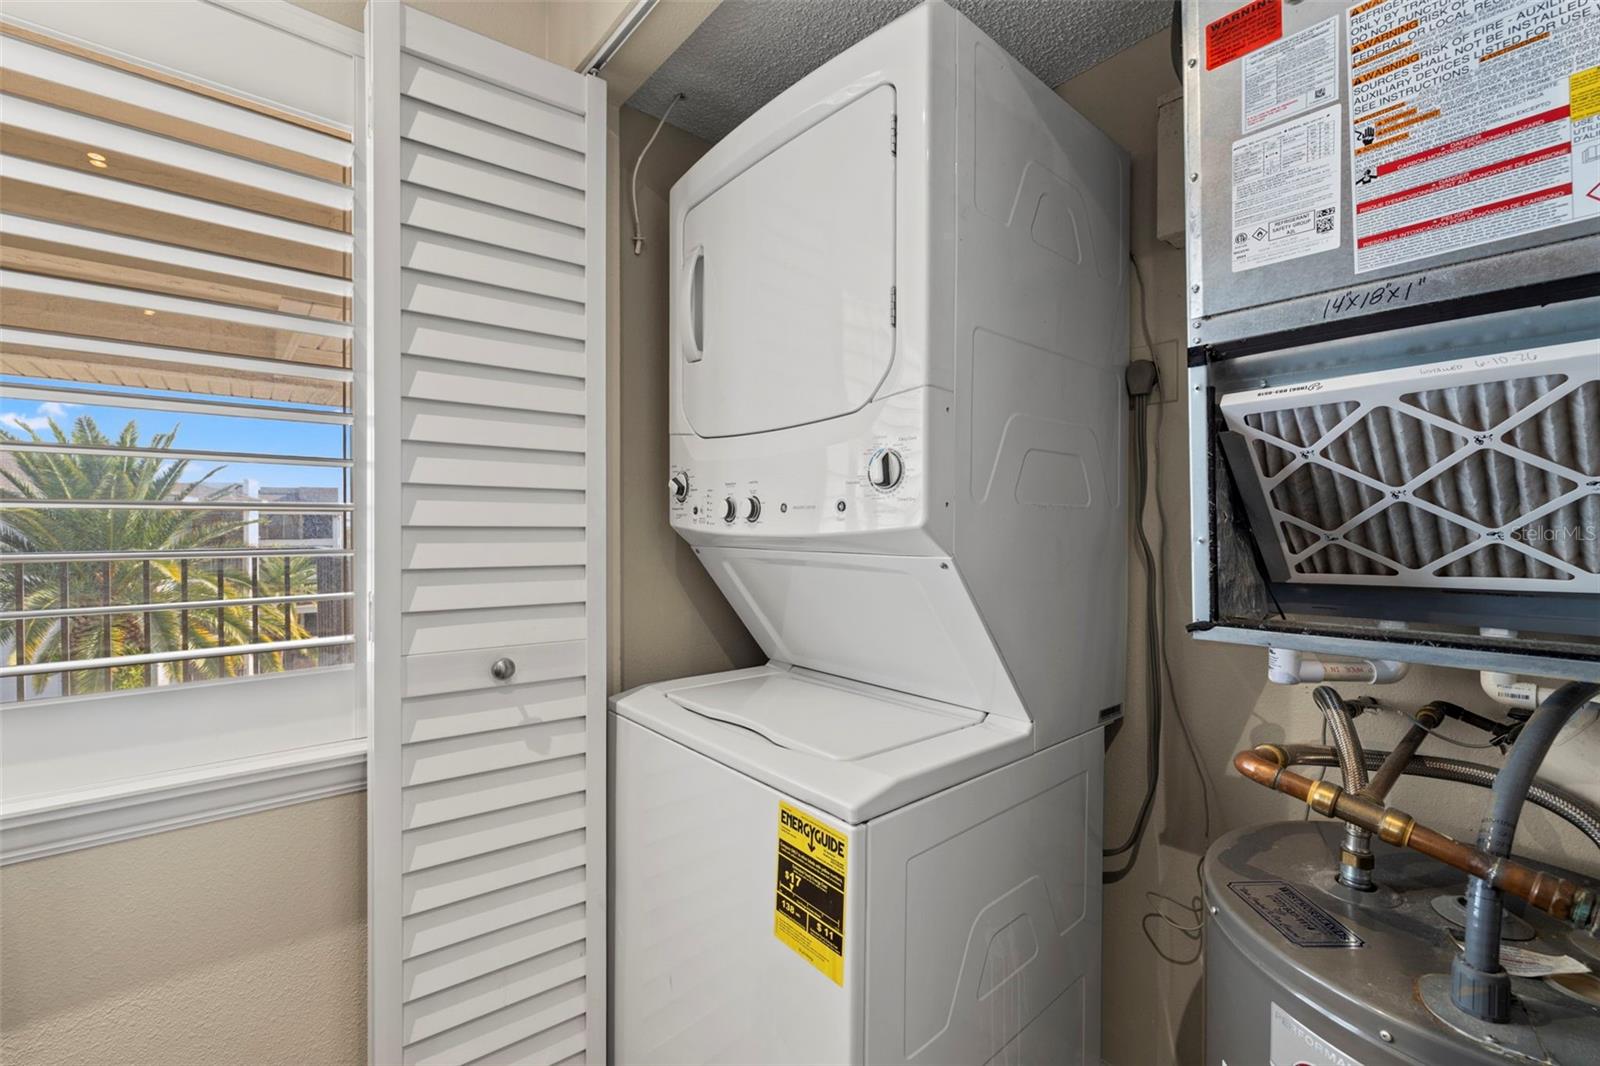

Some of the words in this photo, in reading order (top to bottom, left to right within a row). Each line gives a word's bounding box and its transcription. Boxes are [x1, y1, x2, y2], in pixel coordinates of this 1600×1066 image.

[1351, 16, 1382, 36] ONLY
[1384, 8, 1398, 21] BY
[1352, 31, 1367, 45] DO
[1370, 19, 1394, 37] NOT
[1353, 35, 1402, 63] FEDERAL
[1407, 26, 1424, 40] OR
[1430, 7, 1470, 30] LOCAL
[1361, 19, 1418, 50] WARNING
[1420, 6, 1446, 24] RISK
[1353, 67, 1408, 96] SOURCES
[1412, 50, 1450, 72] SHALL
[1454, 38, 1480, 55] NOT
[1486, 29, 1503, 43] BE
[1508, 0, 1588, 34] INSTALLED
[1354, 76, 1412, 106] AUXILIARY
[1416, 53, 1469, 81] DEVICES
[1473, 32, 1520, 59] LISTED
[1526, 19, 1556, 38] FOR
[1560, 5, 1591, 25] USE
[1362, 52, 1418, 82] WARNING
[1420, 40, 1448, 58] RISK
[1452, 31, 1468, 45] OF
[1473, 17, 1503, 37] FIRE
[1354, 100, 1376, 115] SEE
[1573, 116, 1592, 128] USE
[1397, 156, 1426, 169] CARBON
[1428, 143, 1466, 159] MONOXIDE
[1512, 119, 1544, 133] HAZARD
[1450, 133, 1482, 148] DANGER
[1438, 171, 1470, 185] DANGER
[1457, 176, 1468, 184] AU
[1514, 160, 1526, 168] DE
[1527, 148, 1568, 164] CARBONE
[1274, 213, 1311, 227] REFRIGERANT
[1450, 216, 1464, 224] POR
[1522, 190, 1564, 205] CARBONO
[1272, 224, 1291, 233] SAFETY
[1291, 219, 1312, 229] GROUP
[781, 809, 845, 858] ENERGYGUIDE
[785, 871, 801, 886] $17
[1275, 1011, 1352, 1066] PERFORMA
